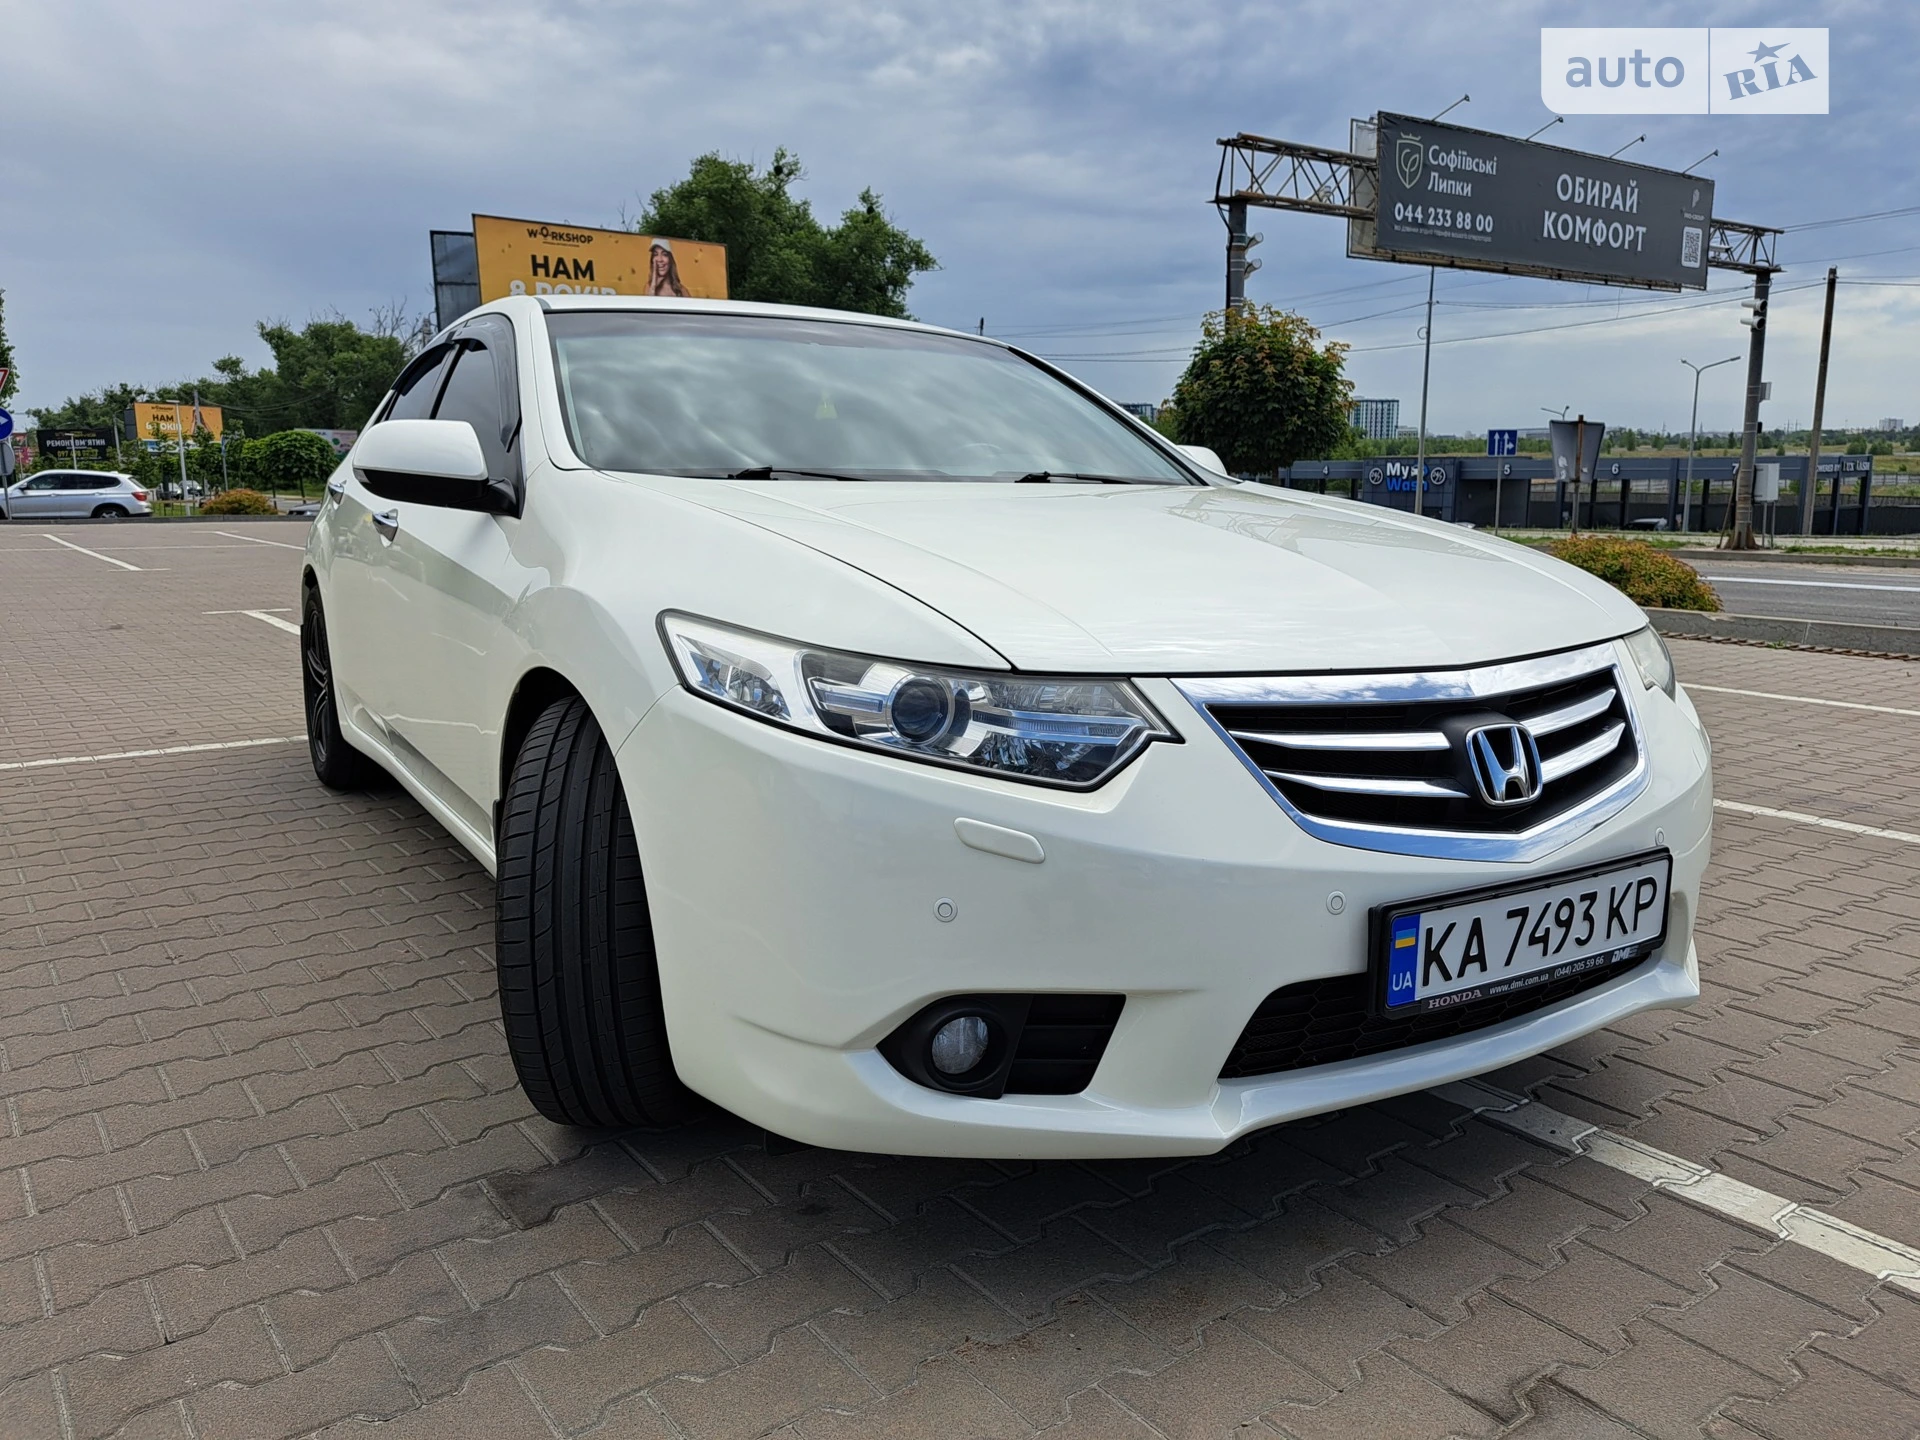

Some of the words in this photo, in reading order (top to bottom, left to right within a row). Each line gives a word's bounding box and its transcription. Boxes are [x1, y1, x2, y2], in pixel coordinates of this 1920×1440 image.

[1428, 144, 1498, 175] Софіївські
[1427, 171, 1472, 197] Липки
[1556, 173, 1639, 213] ОБИРАЙ
[1394, 202, 1423, 223] 044
[1428, 206, 1452, 227] 233
[1456, 210, 1472, 230] 88
[1476, 213, 1494, 233] 00
[1543, 210, 1647, 252] КОМФОРТ
[526, 226, 594, 244] WORKSHOP
[531, 254, 595, 281] НАМ
[1322, 465, 1329, 475] 4
[1386, 462, 1410, 479] My
[1503, 464, 1511, 475] 5
[1611, 463, 1620, 475] 6
[1392, 971, 1413, 991] UA
[1422, 917, 1488, 987] KA
[1504, 891, 1598, 967] 7493
[1606, 876, 1658, 939] KP
[1427, 989, 1482, 1009] HONDA
[1489, 973, 1549, 995] www.dmi.com.ua
[1554, 965, 1572, 979] (044)
[1572, 960, 1585, 972] 205
[1586, 957, 1595, 969] 59
[1595, 954, 1604, 966] 66
